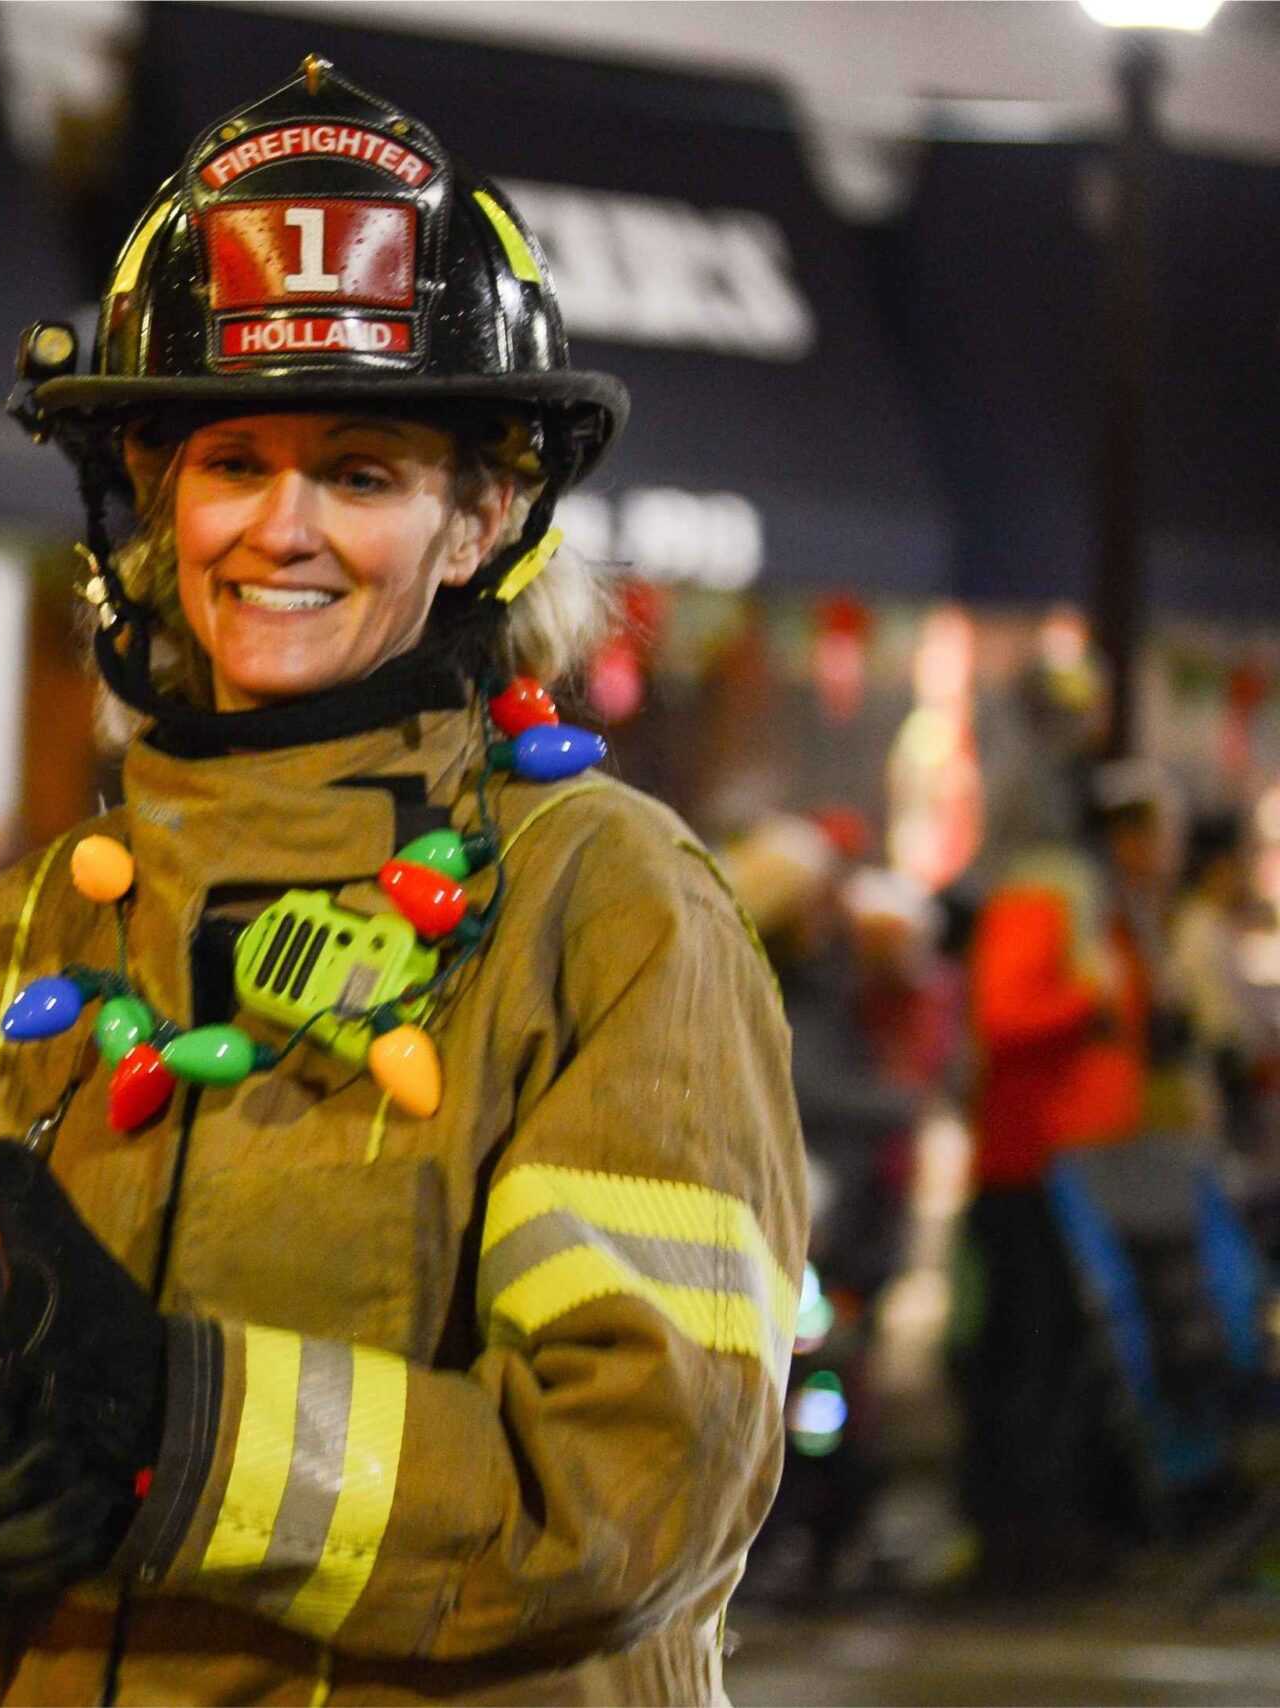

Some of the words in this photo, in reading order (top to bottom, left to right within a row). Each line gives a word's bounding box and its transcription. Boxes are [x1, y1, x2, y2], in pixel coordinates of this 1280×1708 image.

[211, 126, 426, 185] FIREFIGHTER
[284, 207, 340, 292] 1
[240, 321, 392, 352] HOLLAND
